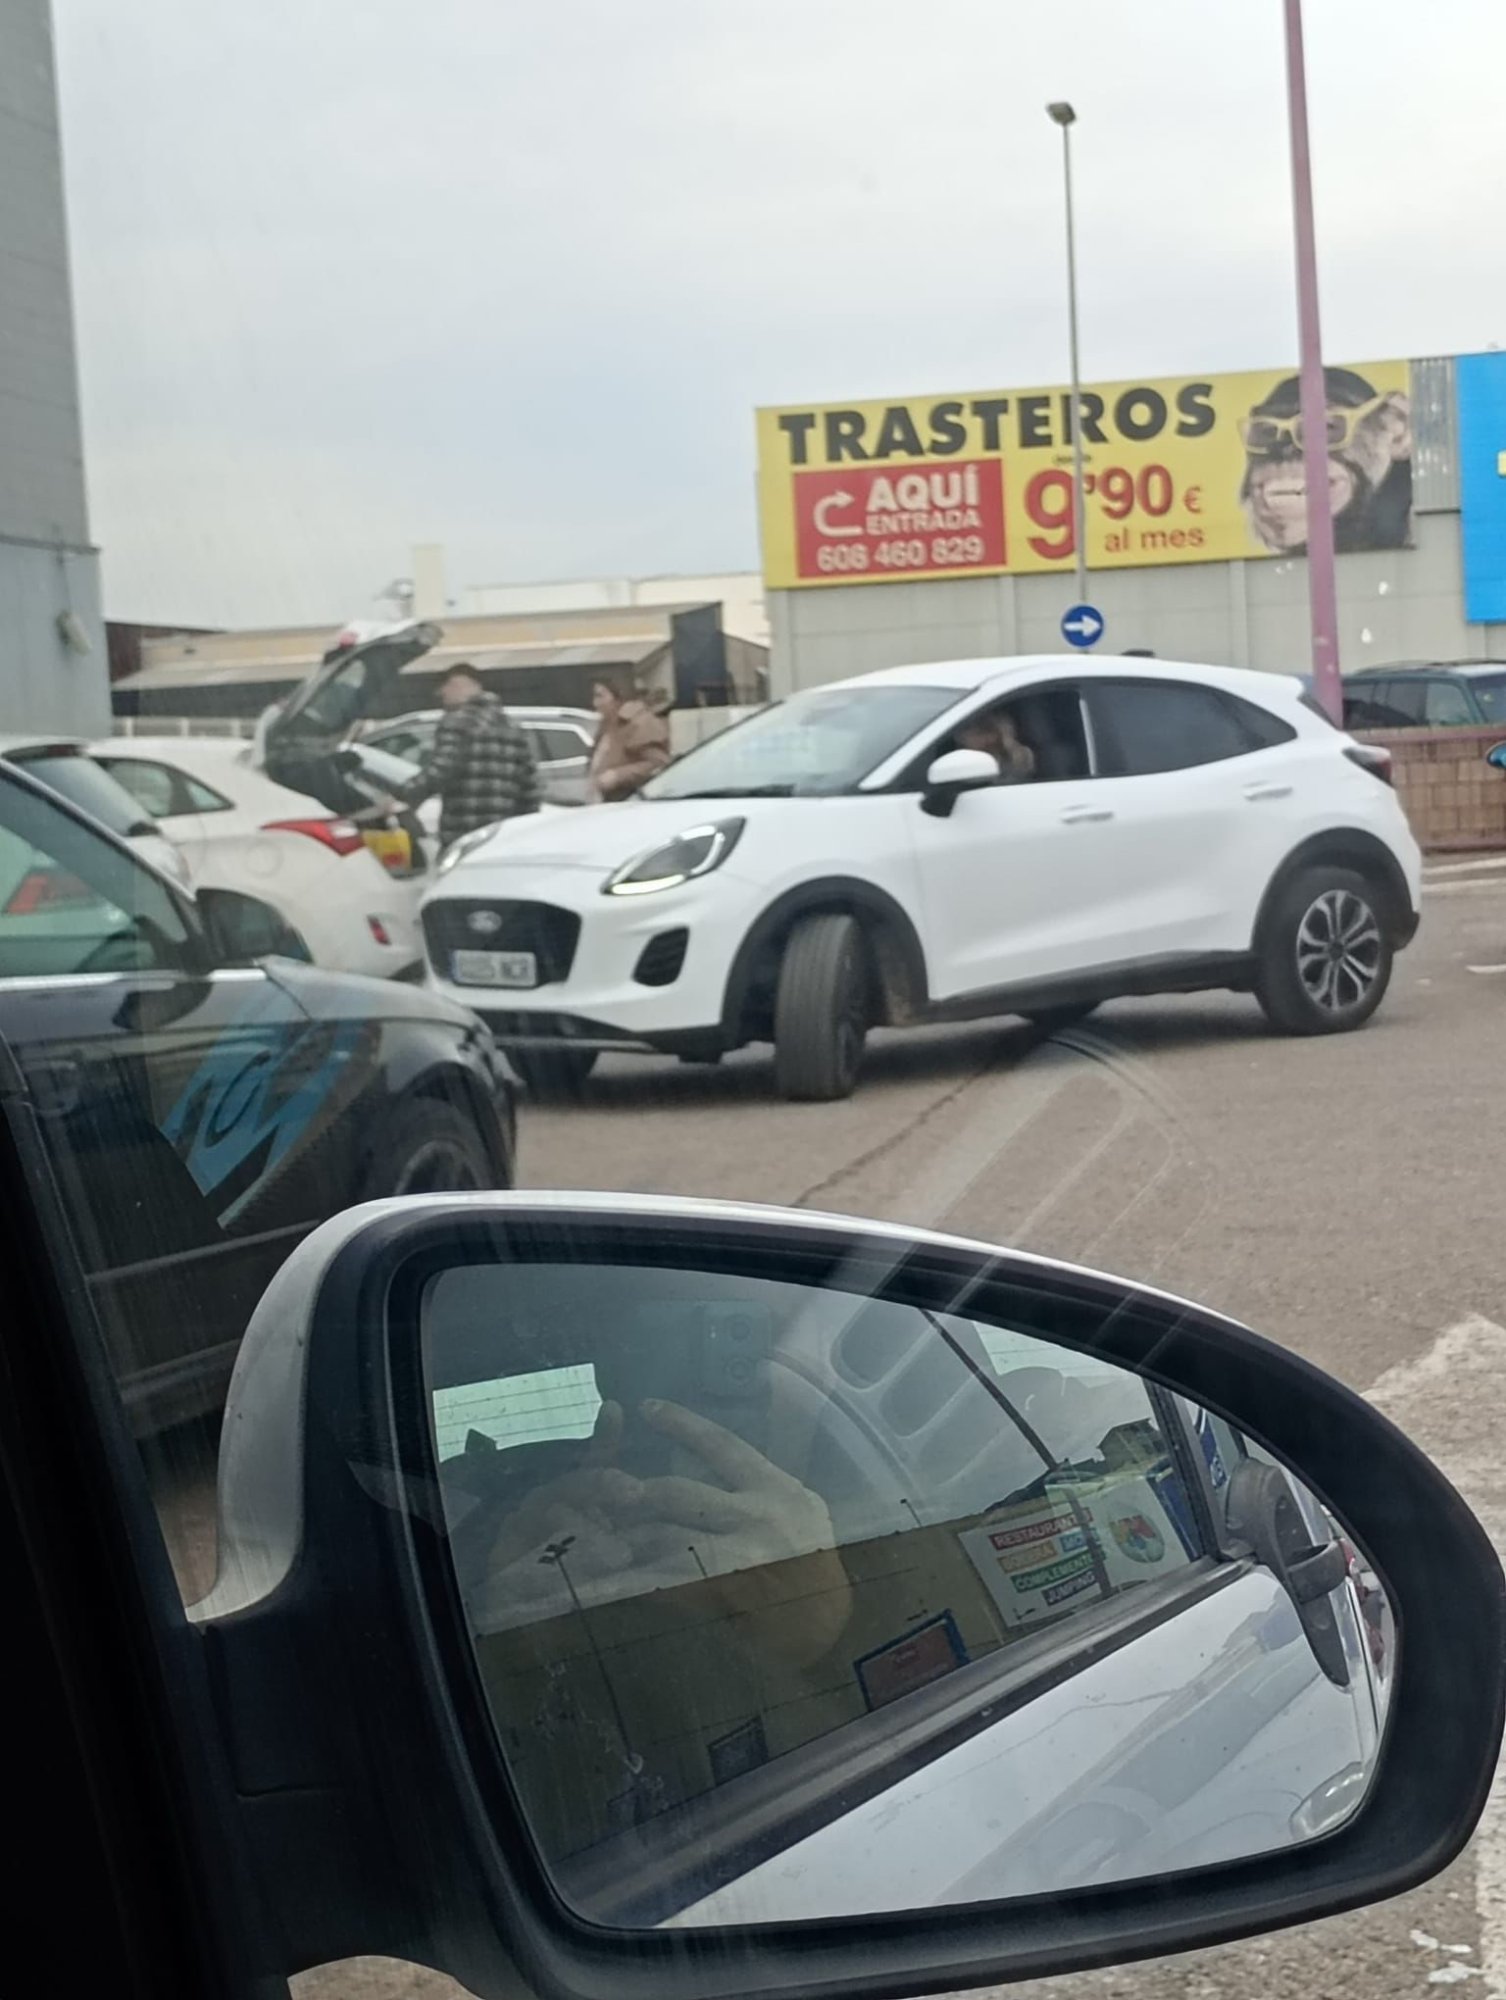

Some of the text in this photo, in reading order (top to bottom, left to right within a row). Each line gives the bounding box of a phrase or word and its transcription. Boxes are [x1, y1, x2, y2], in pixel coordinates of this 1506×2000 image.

[779, 383, 1216, 465] TRASTEROS
[866, 464, 979, 512] AQUÍ
[1184, 485, 1203, 514] €
[866, 509, 982, 536] ENTRADA
[874, 539, 926, 567] 460
[1104, 527, 1205, 553] al mes
